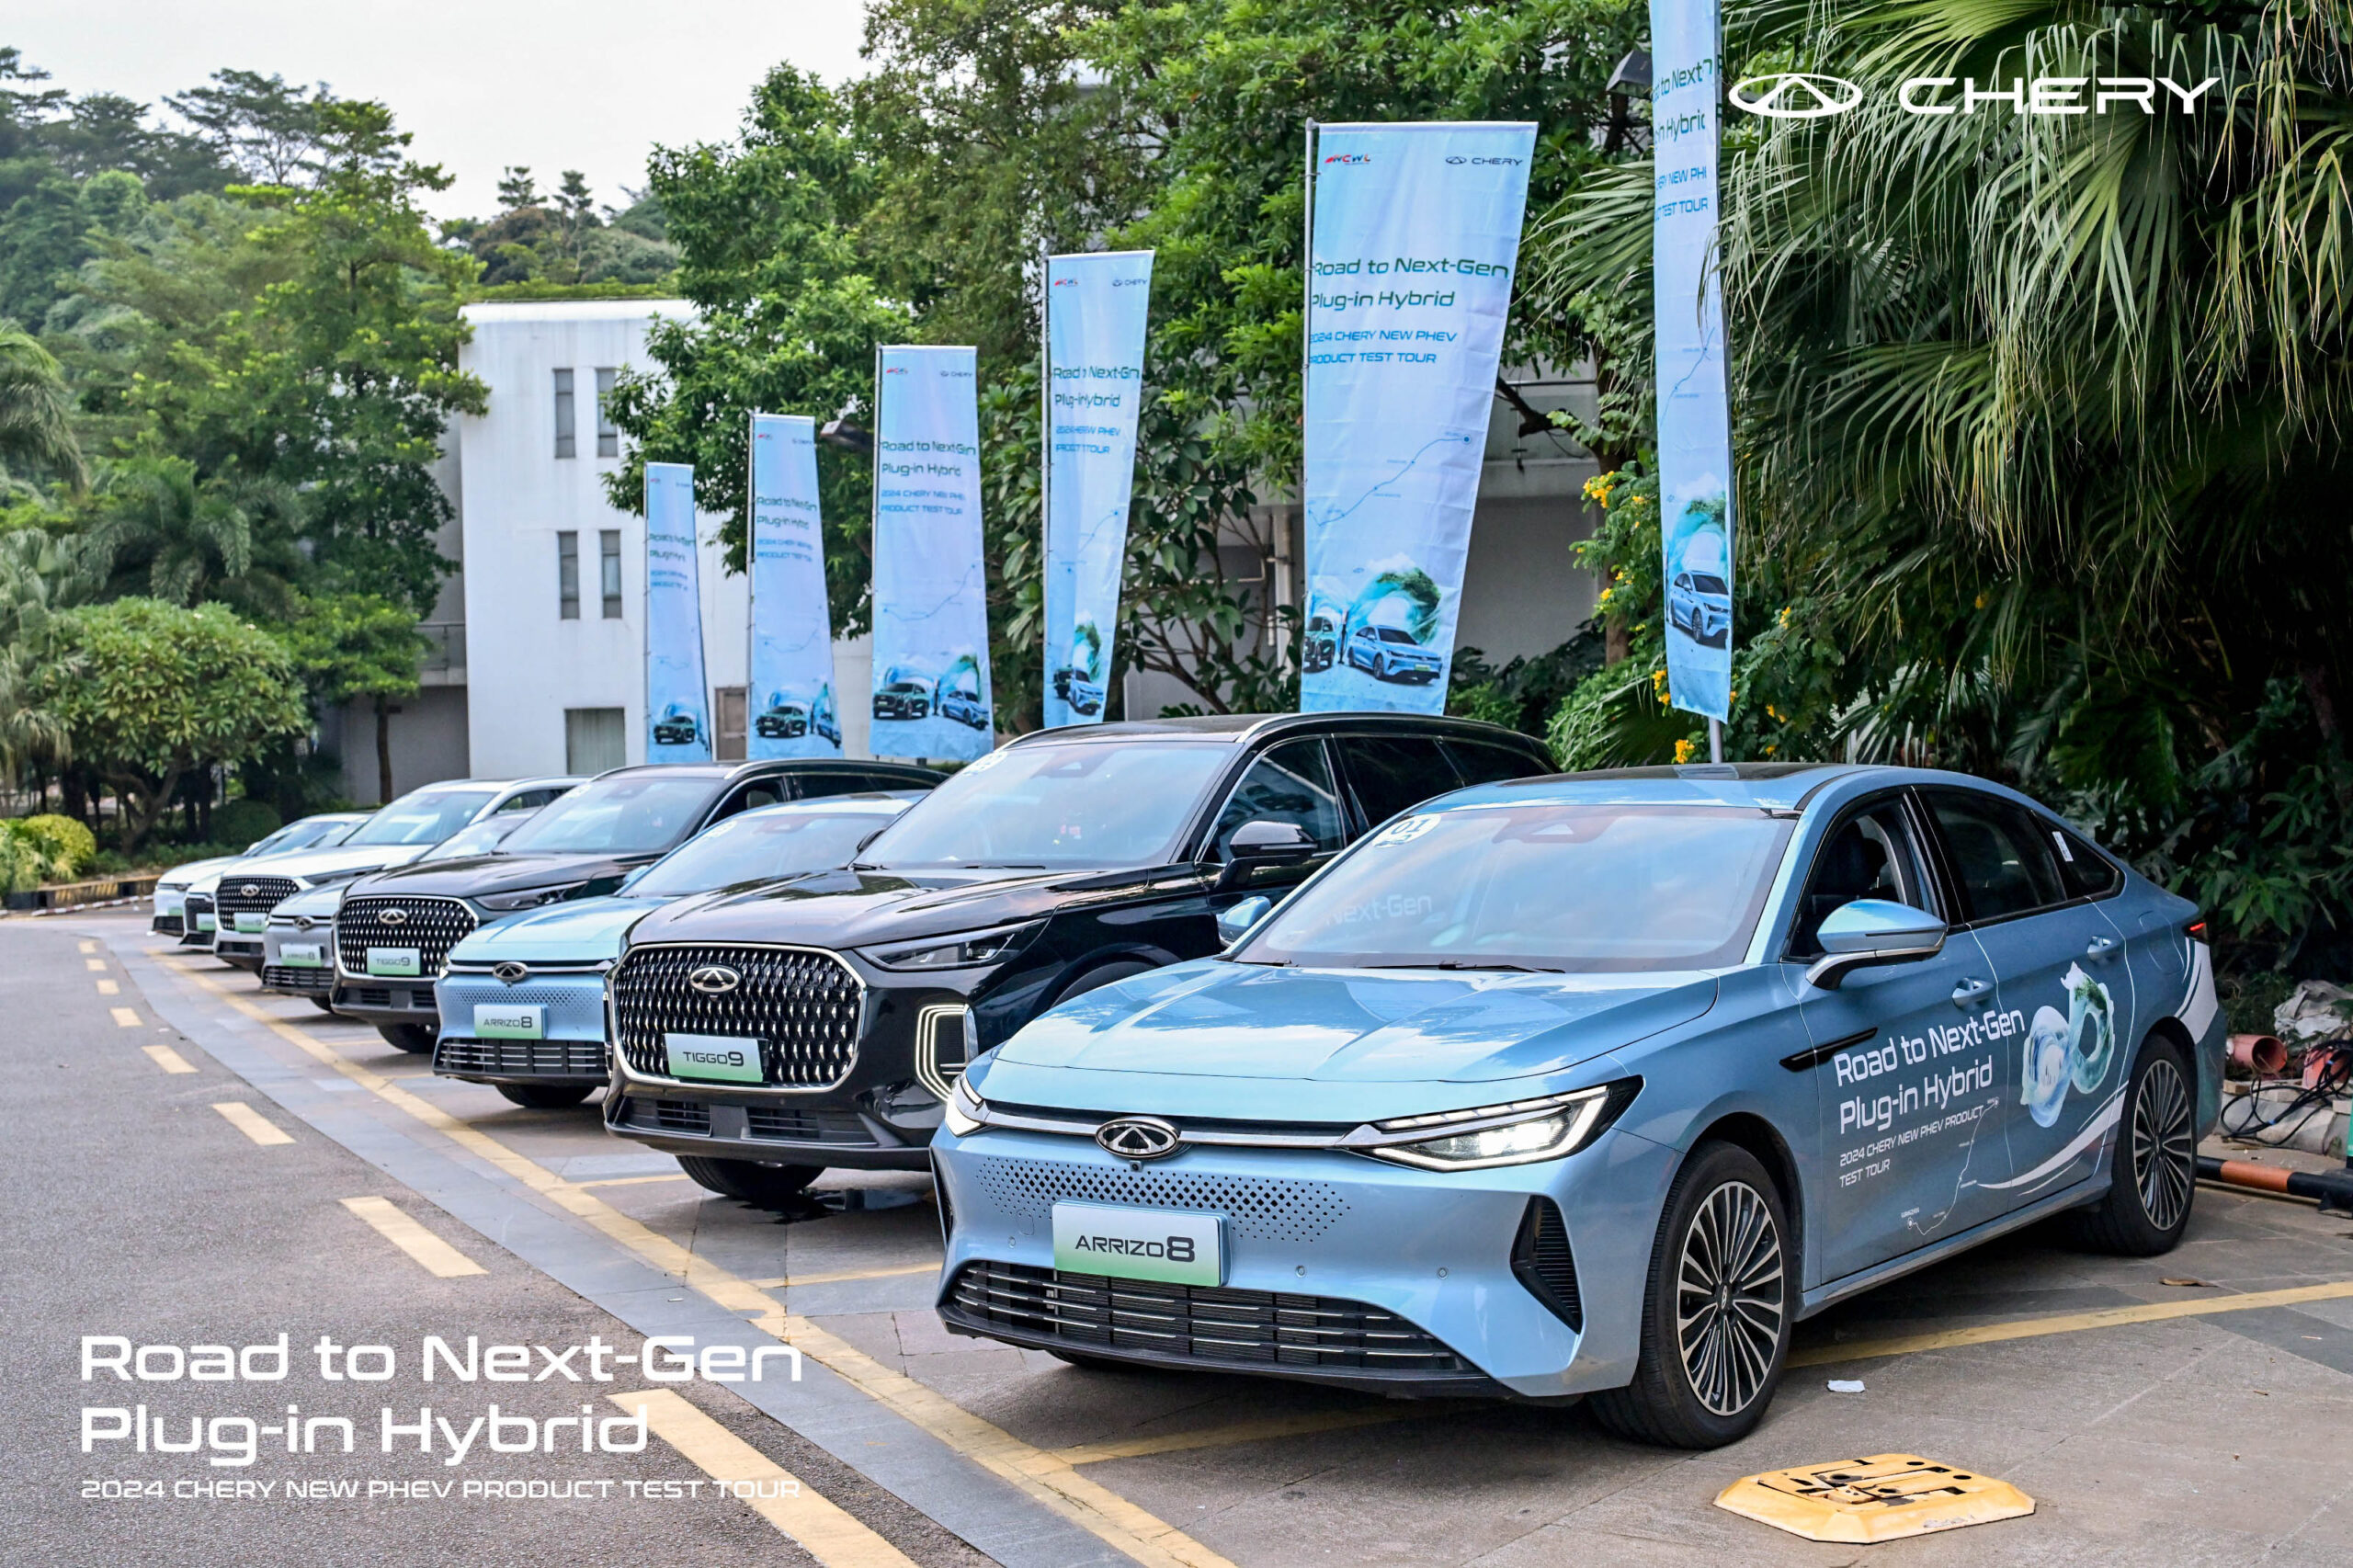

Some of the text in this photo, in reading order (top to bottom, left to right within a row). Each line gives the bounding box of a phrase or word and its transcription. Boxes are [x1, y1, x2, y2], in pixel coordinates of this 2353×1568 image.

[1472, 157, 1523, 166] CHERY
[1679, 197, 1708, 214] TOUR
[1314, 258, 1509, 278] Road to Next-Gen
[1312, 290, 1455, 311] Plug-in Hybrid
[1335, 331, 1377, 341] CHERY
[1379, 331, 1413, 340] NEW
[1415, 331, 1458, 342] PHEV
[1359, 353, 1393, 361] TEST
[1397, 353, 1437, 363] TOUR
[882, 441, 914, 451] Road
[917, 441, 930, 451] to
[882, 462, 924, 476] Plug-in
[1391, 817, 1430, 835] 01
[483, 1017, 532, 1028] ARRIZO8
[1834, 1009, 2026, 1087] Road to Next-Gen
[683, 1051, 745, 1066] TIGGO9
[1840, 1055, 1993, 1134] Plug-in Hybrid
[1840, 1105, 1984, 1167] 2024 CHERY NEW PHEV PRODUCT
[1839, 1159, 1891, 1188] TEST TOUR
[1074, 1234, 1196, 1263] ARRIZO8
